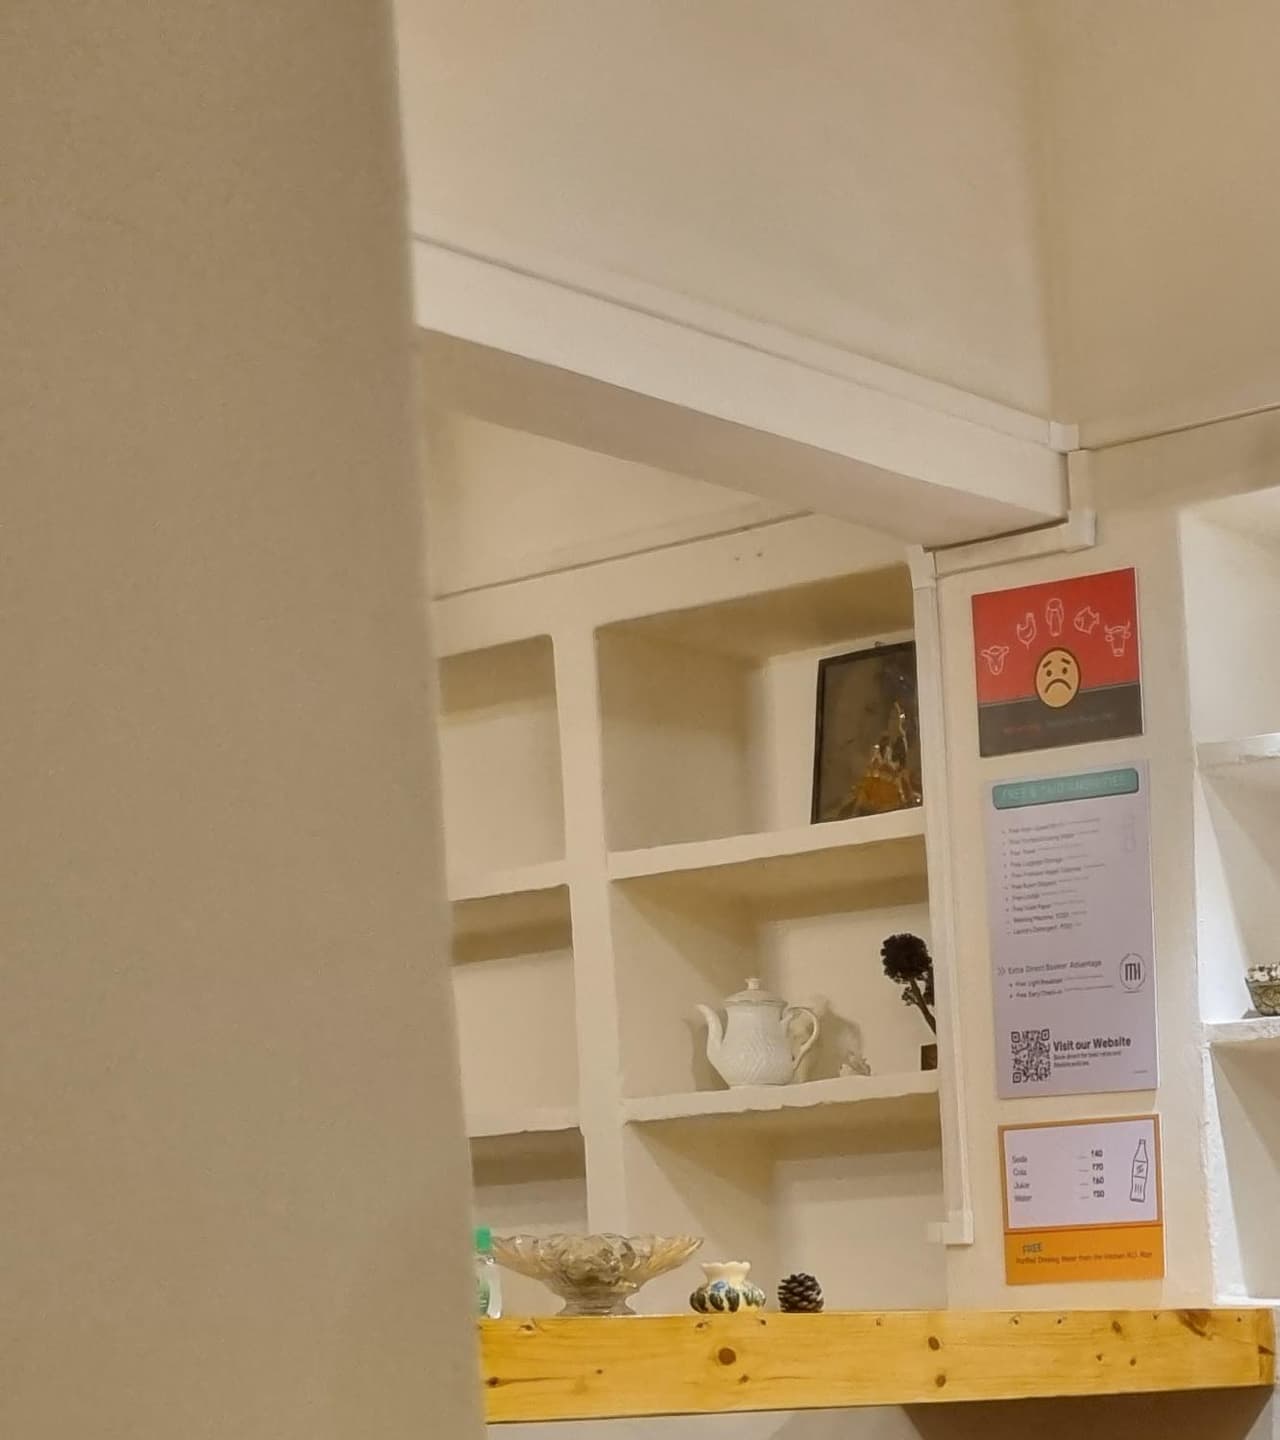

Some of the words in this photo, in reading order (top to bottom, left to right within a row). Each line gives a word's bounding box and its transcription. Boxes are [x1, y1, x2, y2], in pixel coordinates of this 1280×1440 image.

[1053, 1040, 1074, 1052] Visit
[1075, 1041, 1090, 1050] our
[1092, 1037, 1132, 1049] Website
[1022, 1243, 1043, 1255] FREE
